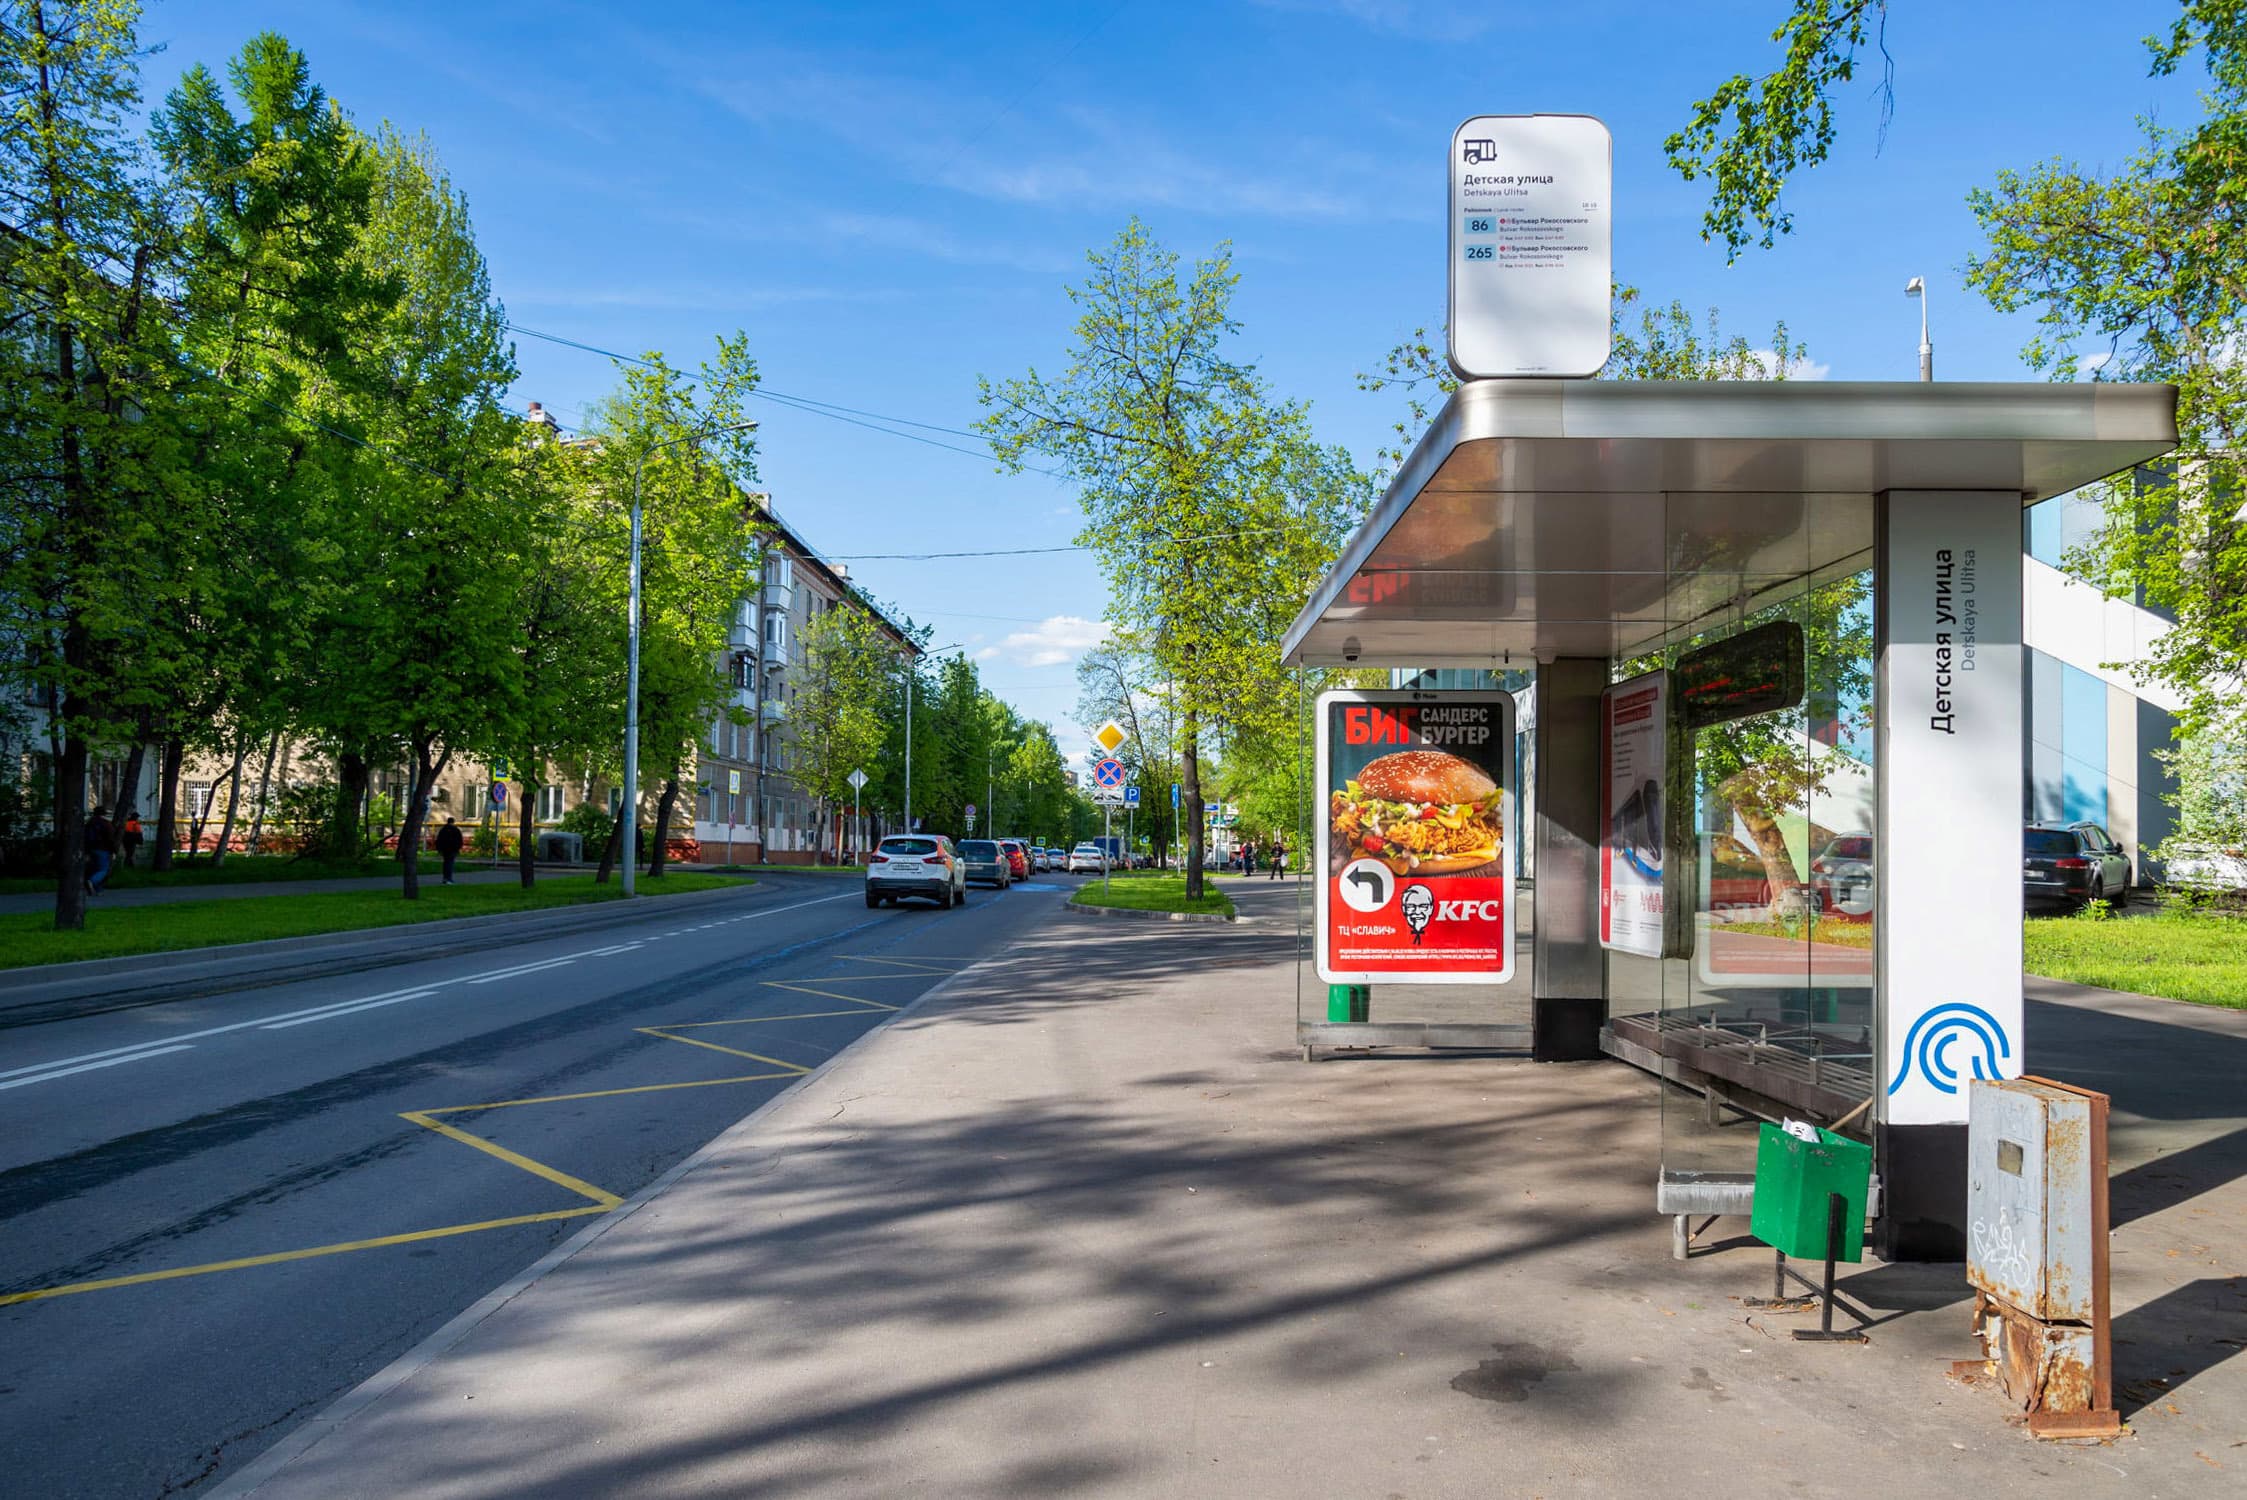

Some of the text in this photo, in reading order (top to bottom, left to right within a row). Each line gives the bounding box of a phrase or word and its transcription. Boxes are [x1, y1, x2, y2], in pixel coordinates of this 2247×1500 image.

[1464, 175, 1554, 185] Детская улица
[1464, 189, 1502, 197] Detskaya
[1471, 220, 1488, 231] 86
[1467, 247, 1492, 259] 265
[1961, 550, 1978, 671] Detskaya Ulitsa
[1931, 549, 1956, 734] Детская улица
[1421, 708, 1488, 725] САНДЕРС
[1345, 707, 1419, 745] БИГ
[1421, 727, 1490, 744] БУРГЕР
[1129, 789, 1137, 800] P
[1435, 900, 1498, 921] KFC
[1338, 926, 1396, 936] ТЦ «СЛАВИЧ»
